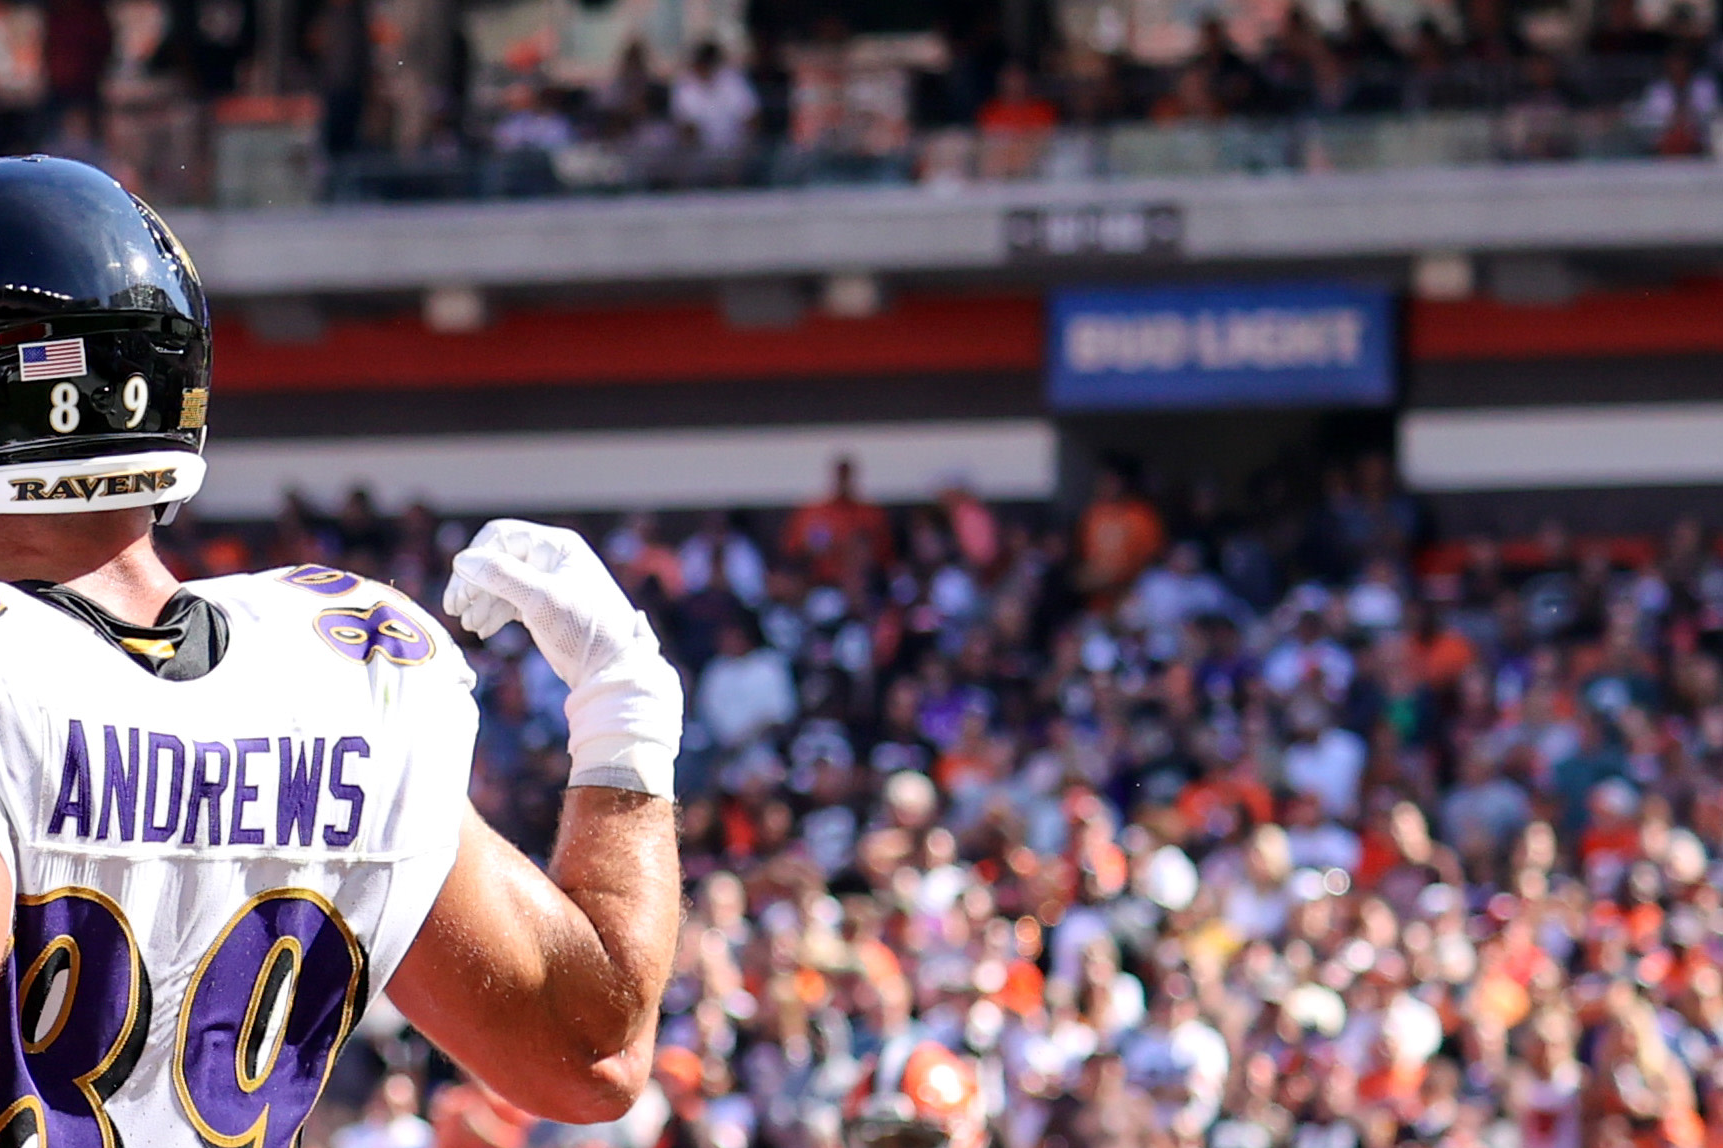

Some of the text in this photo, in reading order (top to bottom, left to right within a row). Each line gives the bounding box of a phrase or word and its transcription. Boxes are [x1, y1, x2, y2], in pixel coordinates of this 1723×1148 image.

[49, 382, 80, 433] 8
[122, 374, 149, 429] 9
[8, 467, 178, 503] RAVENS
[48, 718, 371, 847] ANDREWS
